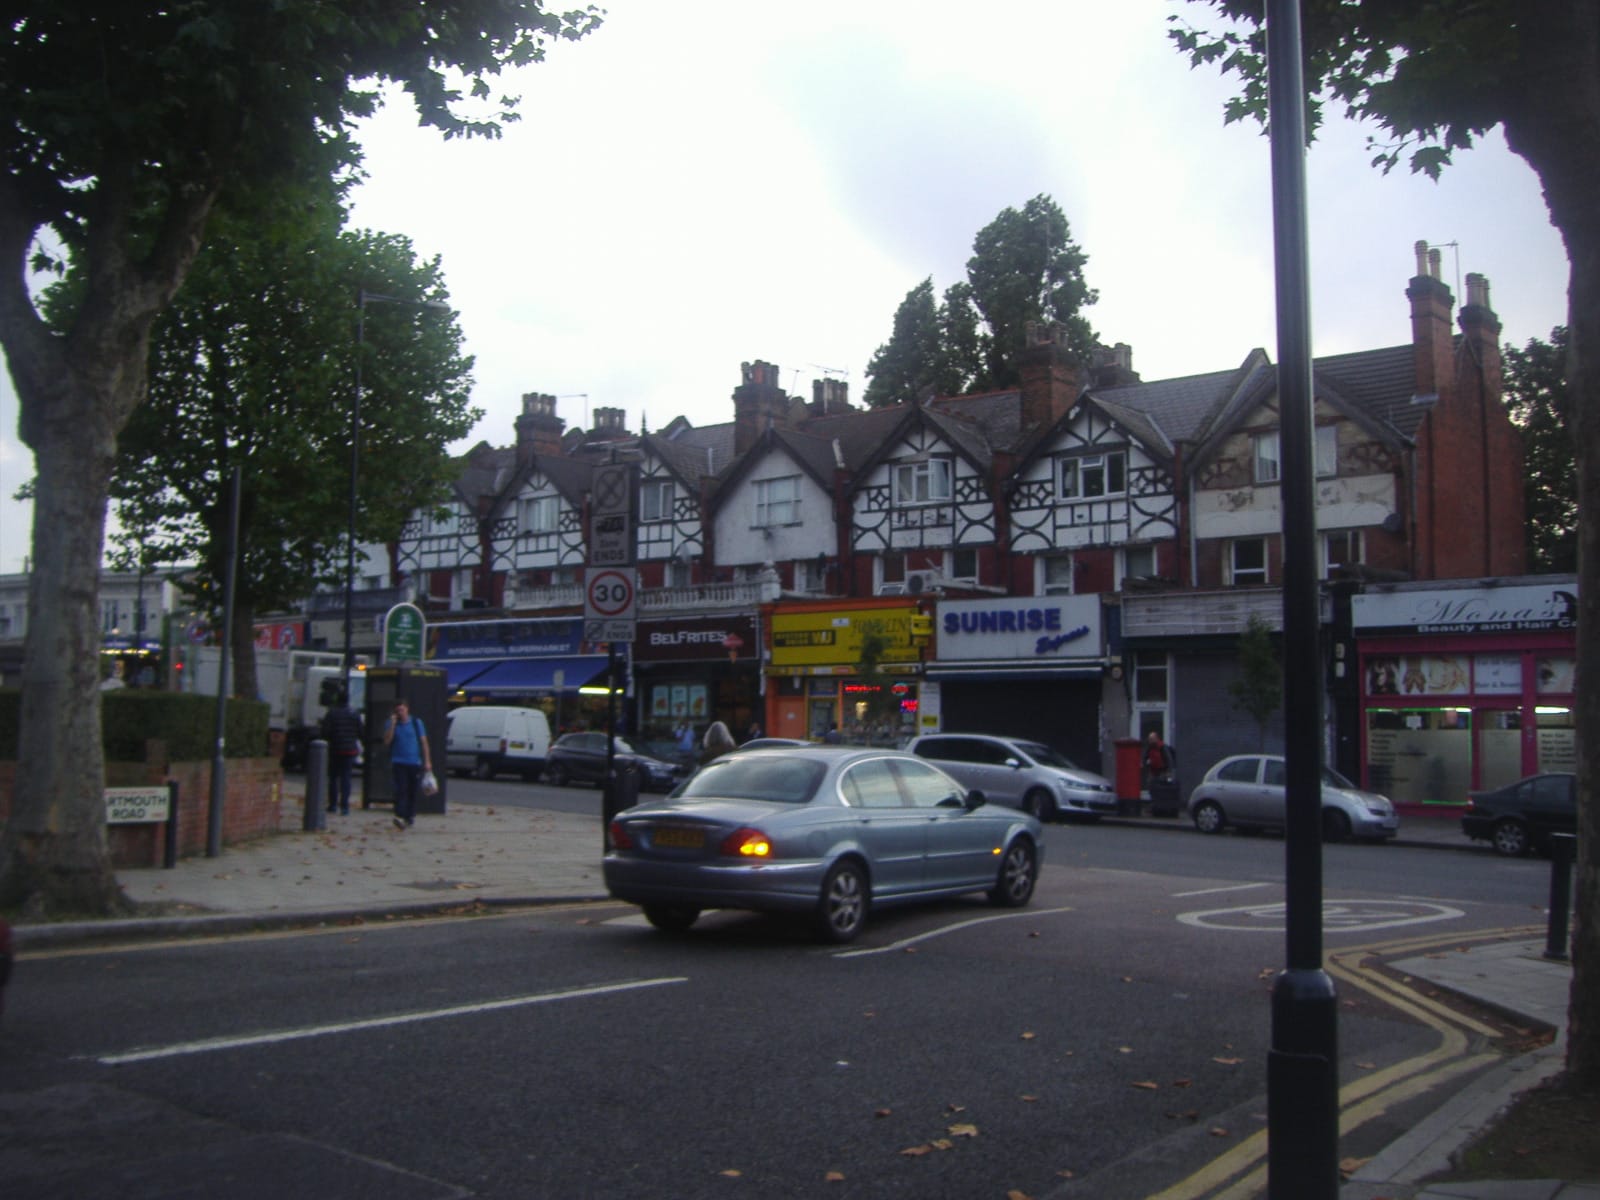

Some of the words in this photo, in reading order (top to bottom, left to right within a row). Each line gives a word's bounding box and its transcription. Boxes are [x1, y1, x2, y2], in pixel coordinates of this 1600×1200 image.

[593, 549, 625, 562] ENDS
[595, 584, 627, 602] 30
[943, 608, 1062, 635] SUNRISE
[1417, 623, 1474, 634] Beauty
[1480, 621, 1512, 631] and
[1516, 620, 1553, 629] Hair
[508, 643, 572, 654] SUPERMARKET
[111, 807, 145, 819] ROAD
